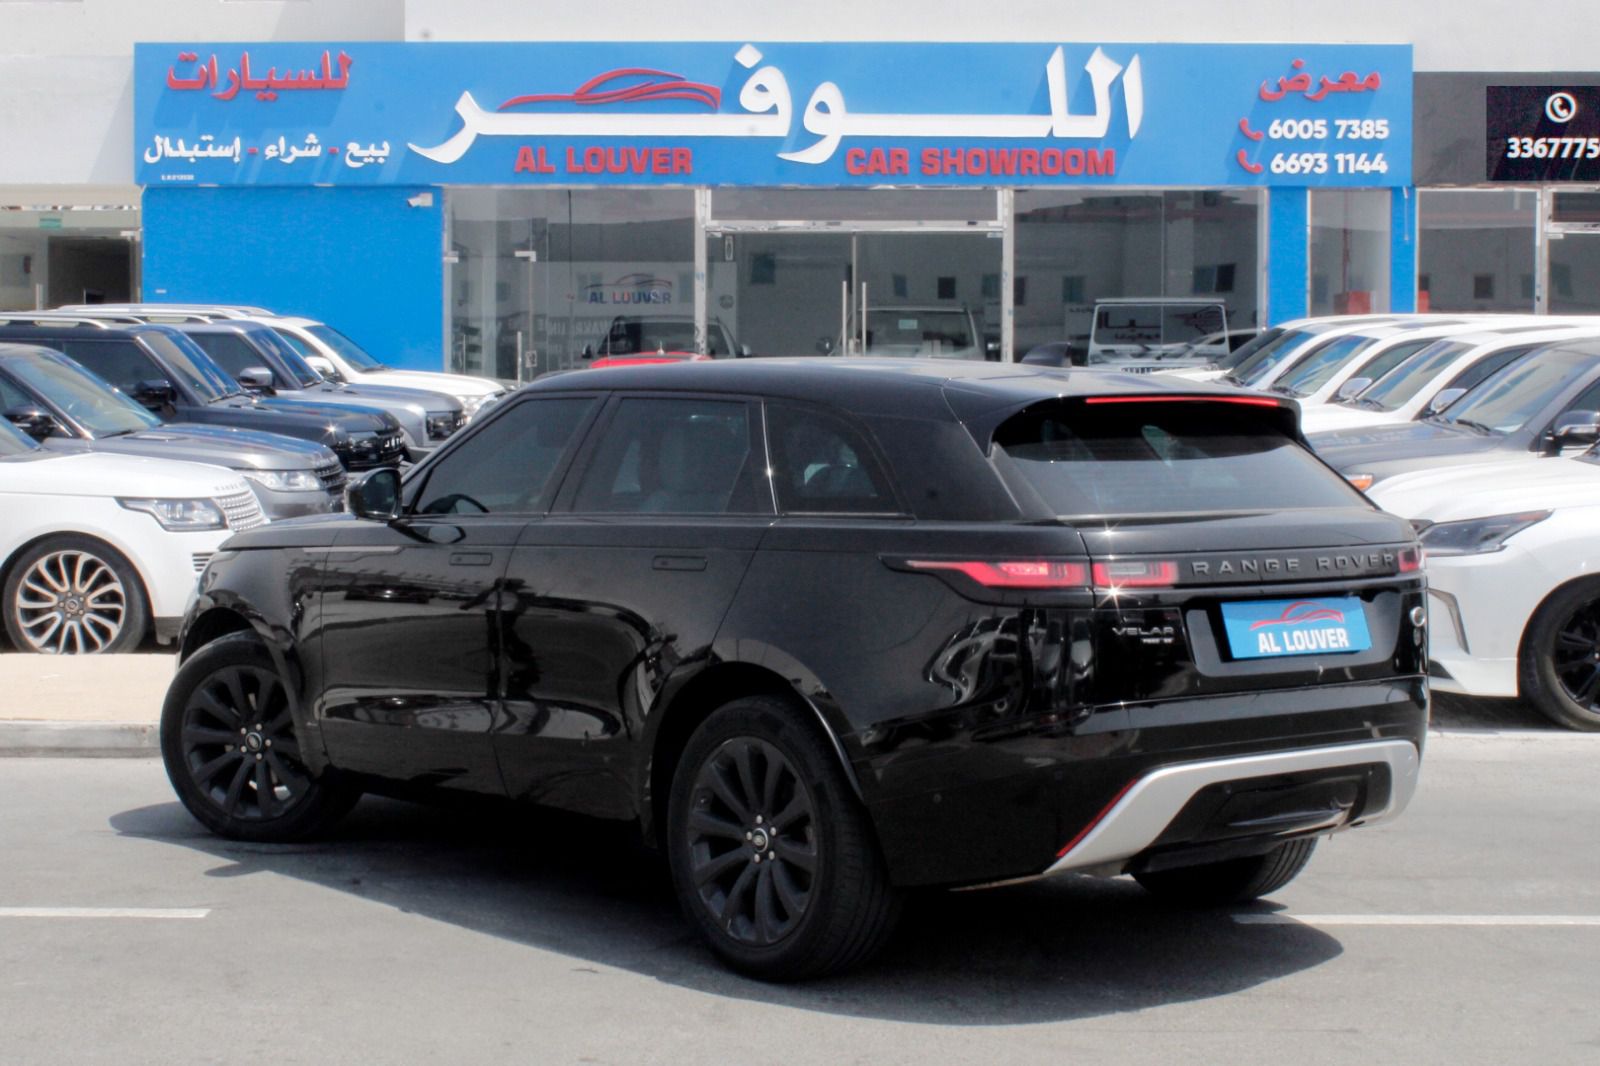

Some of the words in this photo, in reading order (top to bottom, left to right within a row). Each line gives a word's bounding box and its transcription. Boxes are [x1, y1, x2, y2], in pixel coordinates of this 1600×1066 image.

[167, 50, 352, 101] للسيارات
[1260, 59, 1381, 101] معرض
[1268, 119, 1328, 140] 6005
[1335, 119, 1390, 140] 7385
[264, 133, 322, 165] شراء
[344, 140, 391, 168] بيع
[514, 147, 555, 174] AL
[566, 147, 692, 174] LOUVER
[1507, 137, 1600, 159] 3367775
[846, 148, 909, 176] CAR
[921, 148, 1115, 176] SHOWROOM
[1270, 152, 1328, 174] 6693
[1335, 152, 1388, 174] 1144
[589, 291, 608, 304] AL
[1192, 557, 1300, 576] RANGE
[1316, 553, 1395, 571] ROVER
[1112, 626, 1174, 636] VELAR
[1258, 631, 1282, 654] AL
[1284, 627, 1350, 651] LOUVER
